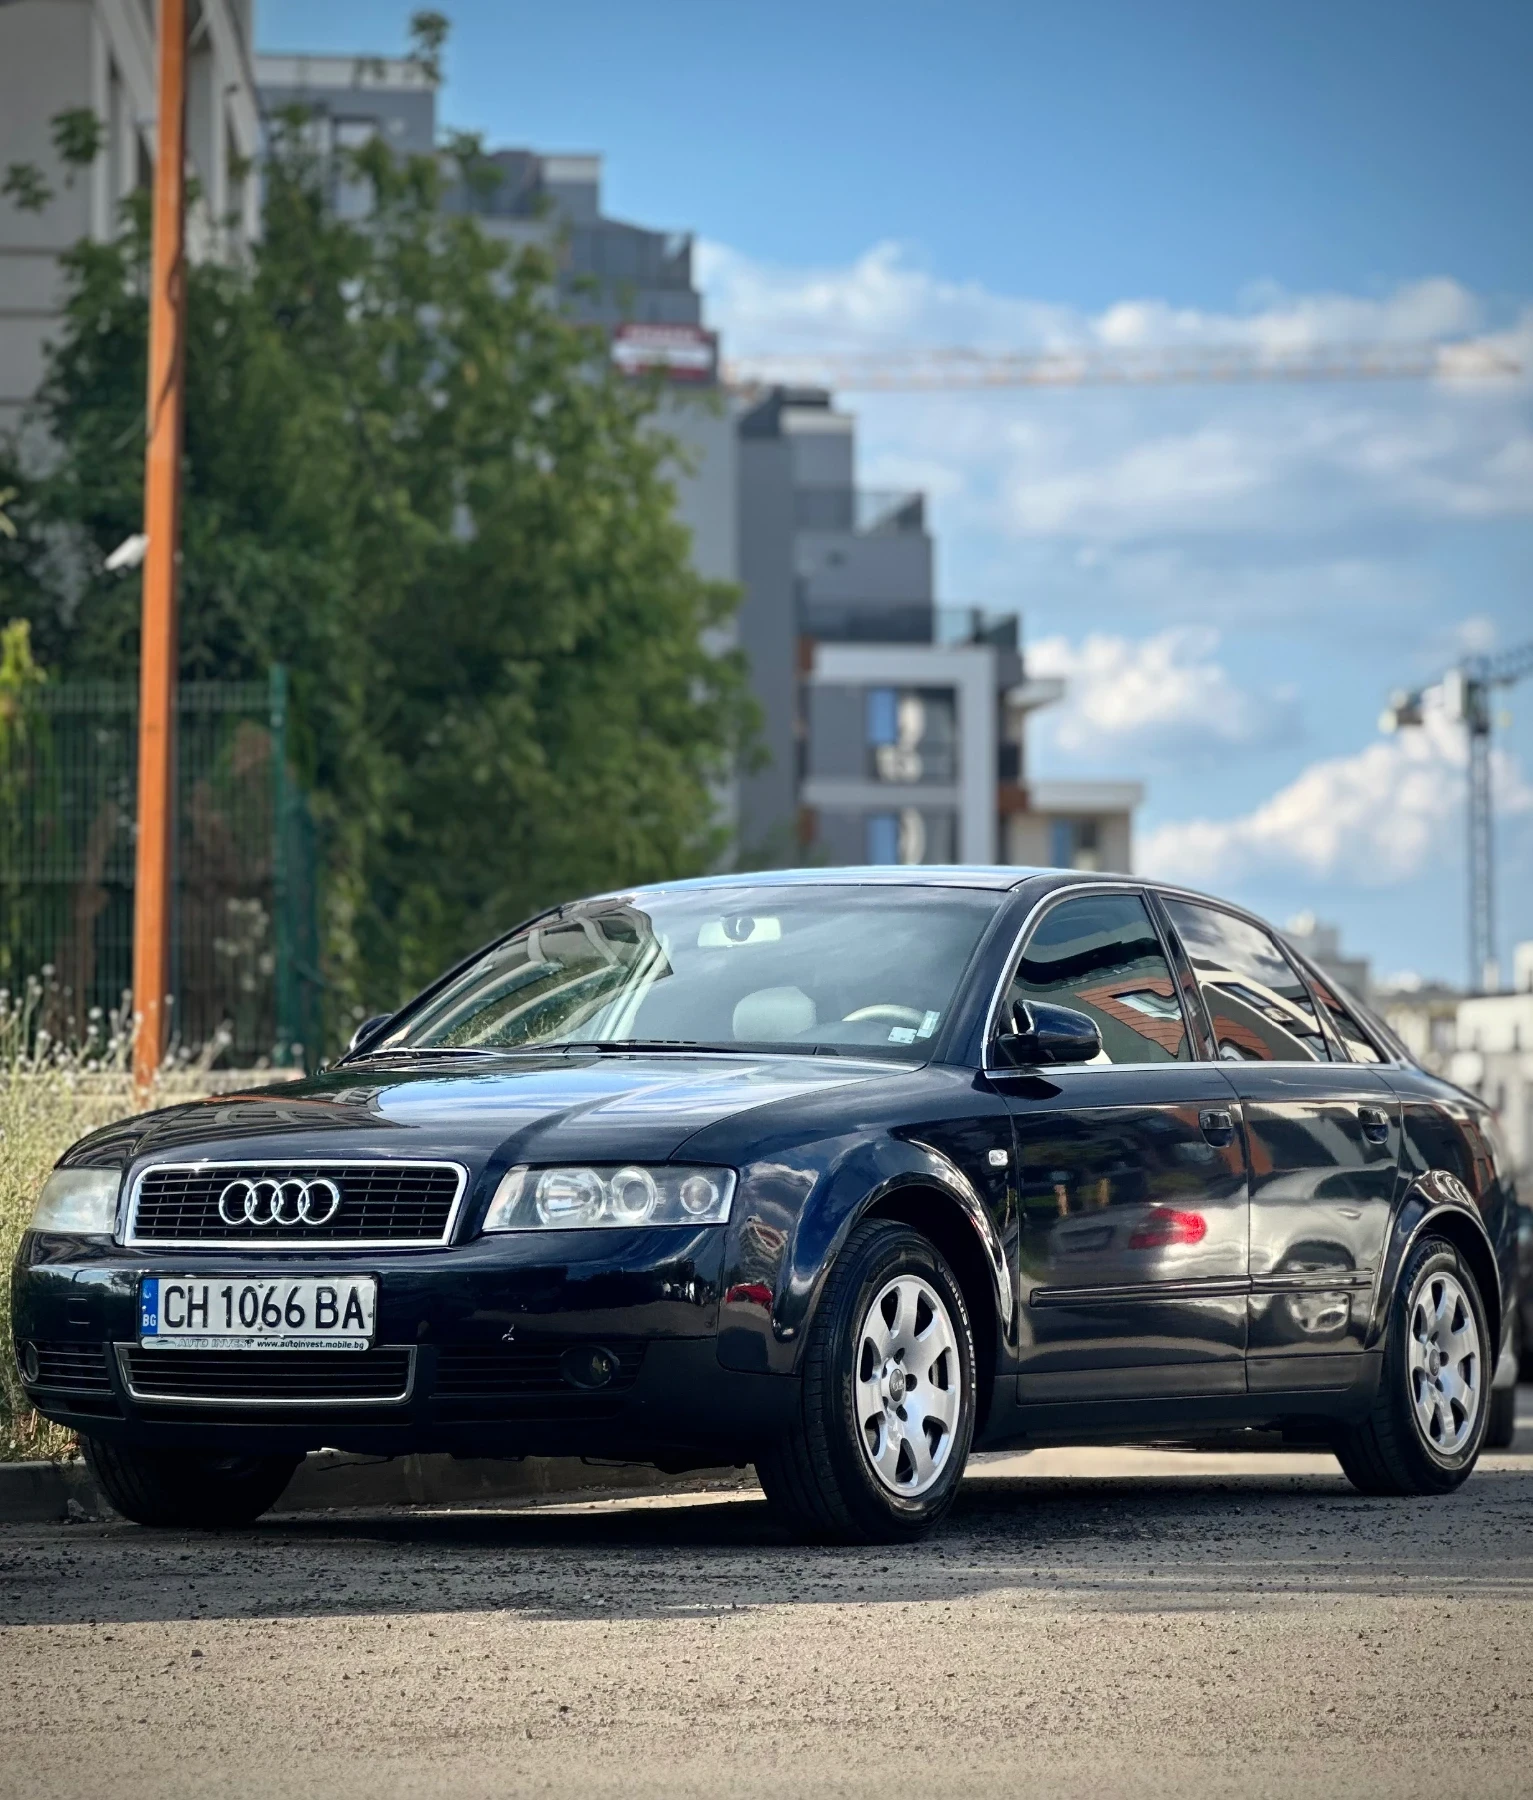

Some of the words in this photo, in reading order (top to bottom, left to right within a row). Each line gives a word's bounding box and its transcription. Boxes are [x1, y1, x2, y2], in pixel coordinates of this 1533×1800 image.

[164, 1285, 209, 1328] CH
[221, 1285, 305, 1329] 1066
[315, 1285, 365, 1329] BA
[142, 1313, 157, 1327] BG
[177, 1338, 209, 1348] AUTO
[257, 1339, 364, 1350] www.autoinvest.mobile.bg
